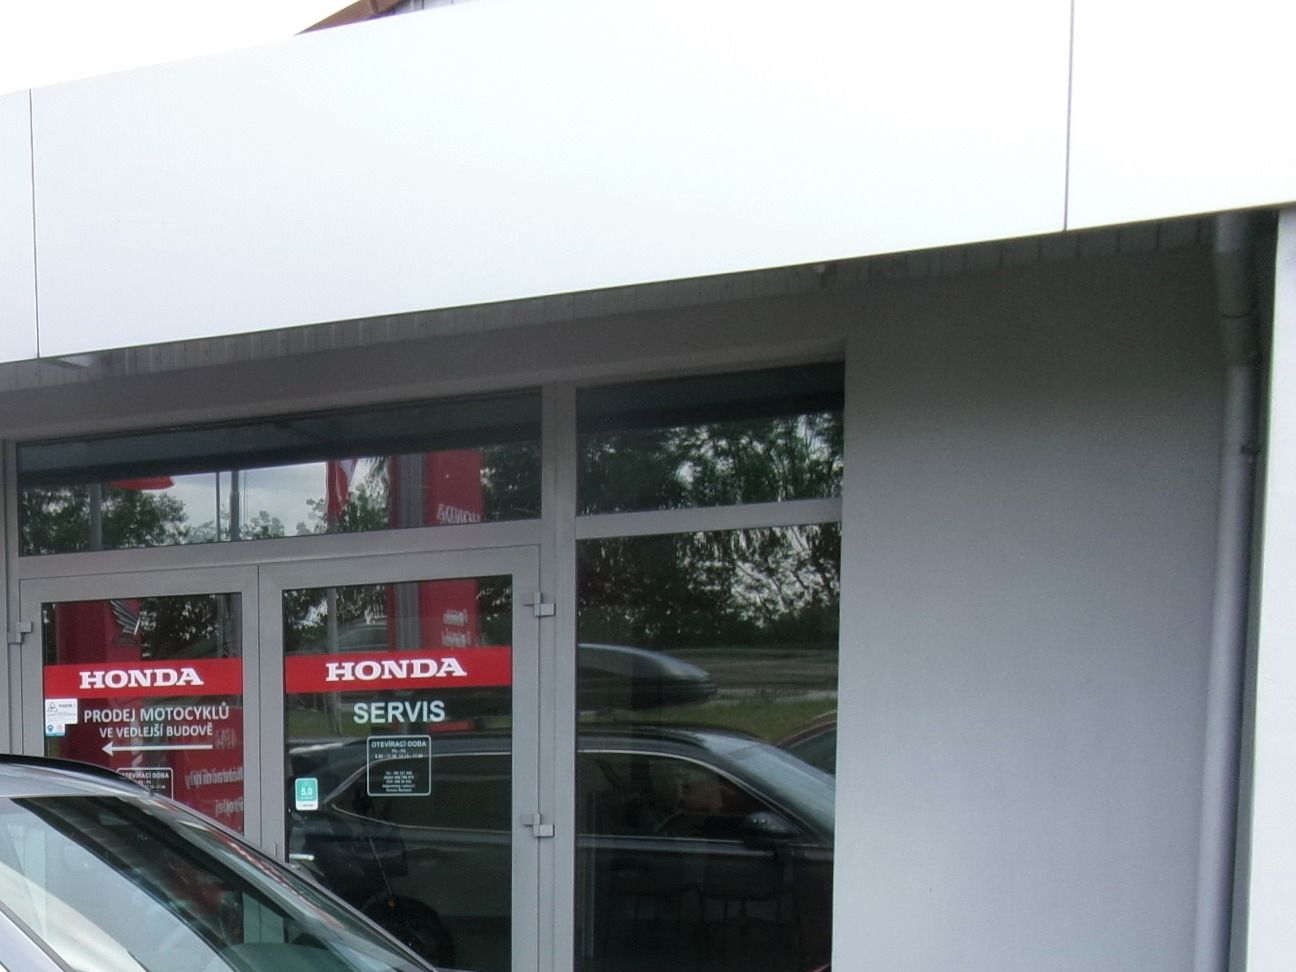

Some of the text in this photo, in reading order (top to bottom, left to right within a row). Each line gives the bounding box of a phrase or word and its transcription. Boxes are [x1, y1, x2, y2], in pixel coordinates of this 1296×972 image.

[79, 668, 204, 689] HONDA
[325, 657, 467, 682] HONDA
[84, 702, 229, 723] PRODEJ MOTOCYKLŮ
[353, 700, 446, 724] SERVIS
[99, 722, 213, 738] VE VEDLEJŠÍ BUDOVĚ
